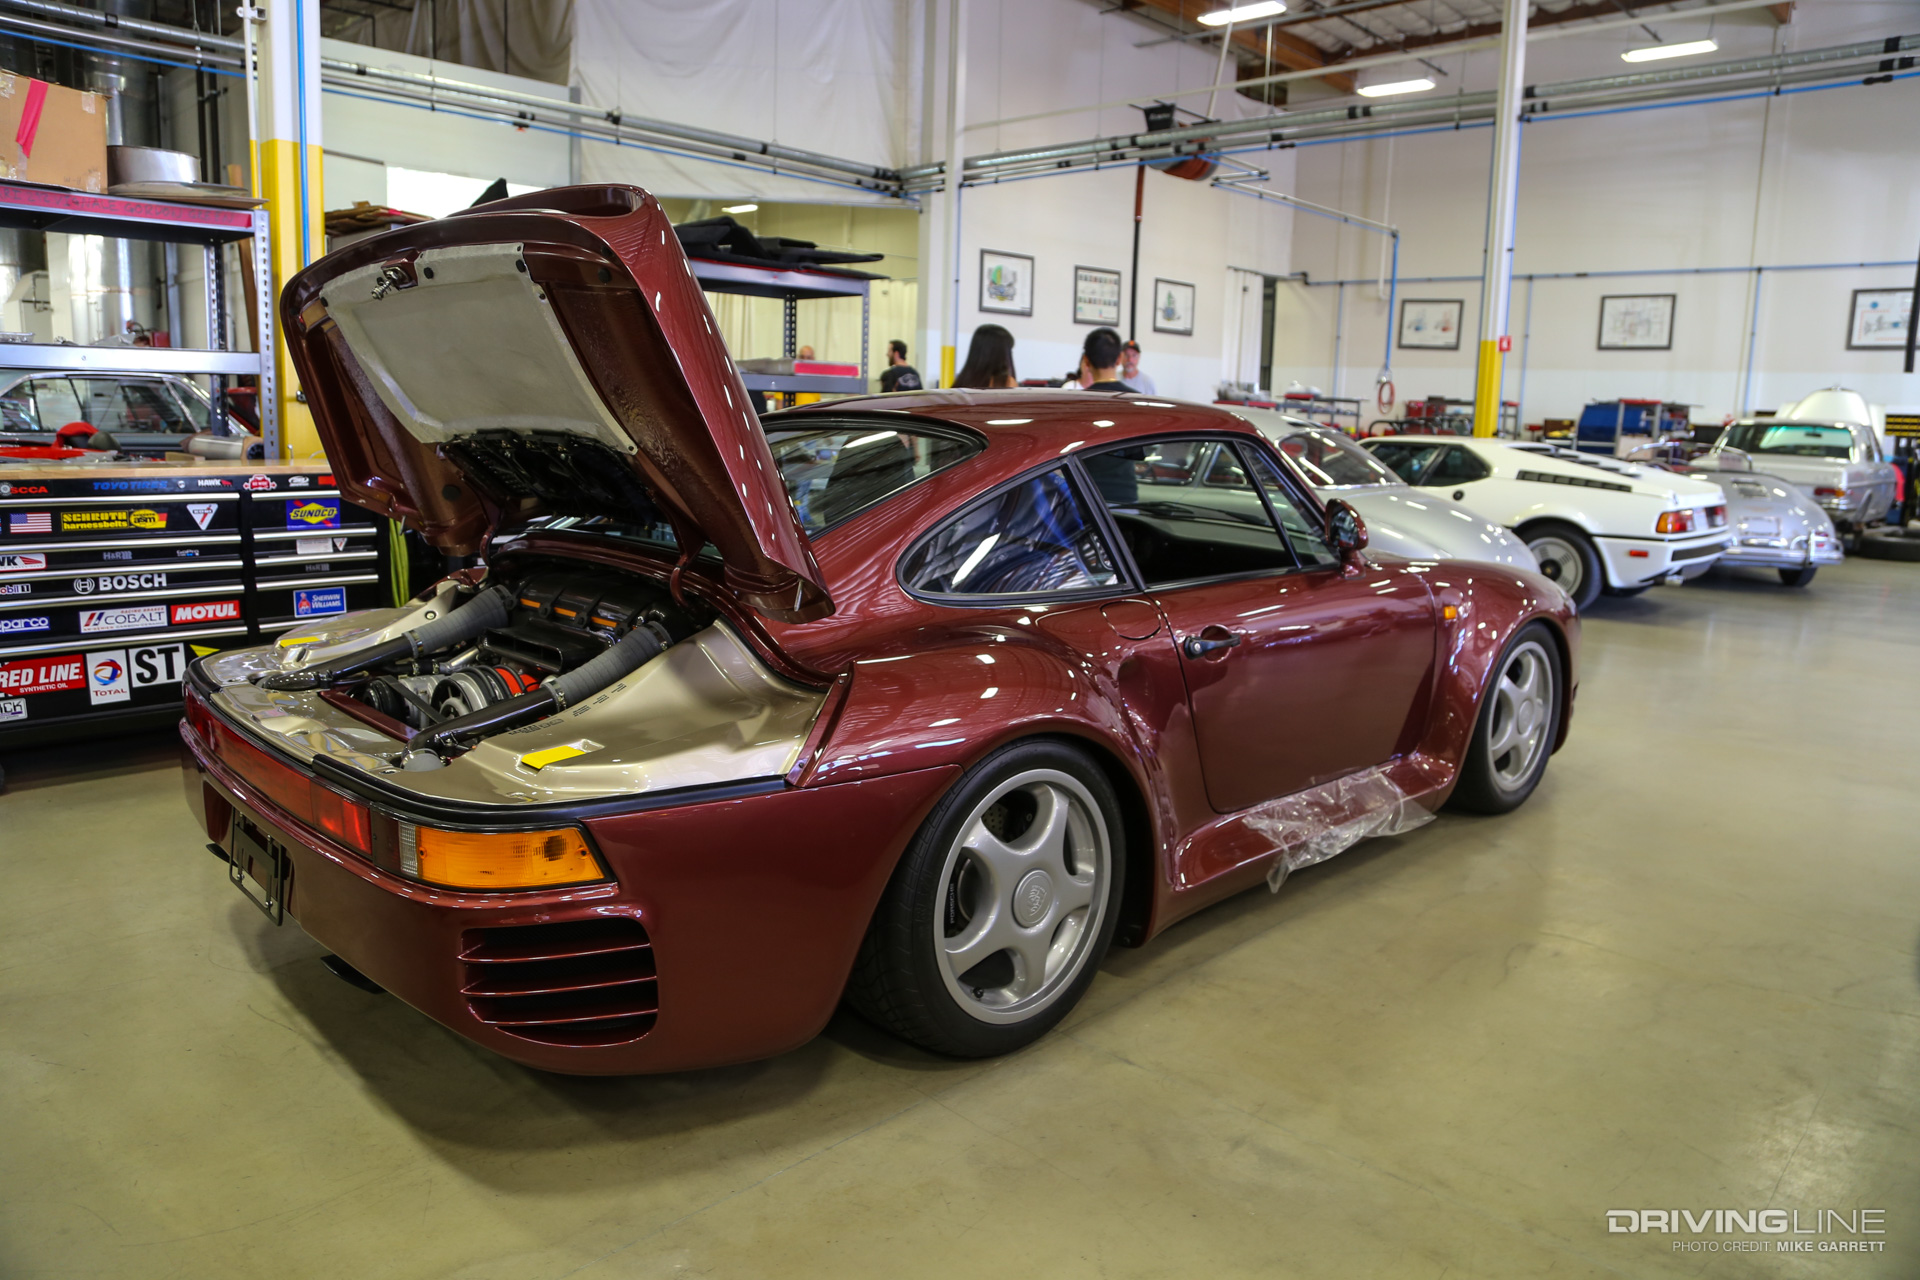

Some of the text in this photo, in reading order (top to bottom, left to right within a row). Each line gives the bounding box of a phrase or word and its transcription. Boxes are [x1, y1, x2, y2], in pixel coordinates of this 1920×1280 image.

[93, 480, 168, 490] TOYO TIRES
[197, 479, 221, 487] HAWK
[10, 486, 48, 494] SCCA
[63, 511, 127, 522] SCHROTH
[292, 508, 334, 518] SUNOCO
[99, 573, 167, 591] BOSCH
[0, 584, 19, 594] obil
[175, 603, 237, 621] MOTUL
[104, 612, 164, 625] COBALT
[0, 617, 49, 633] parco
[135, 646, 180, 684] ST
[0, 668, 34, 688] RED
[19, 684, 56, 693] SYNTHETIC
